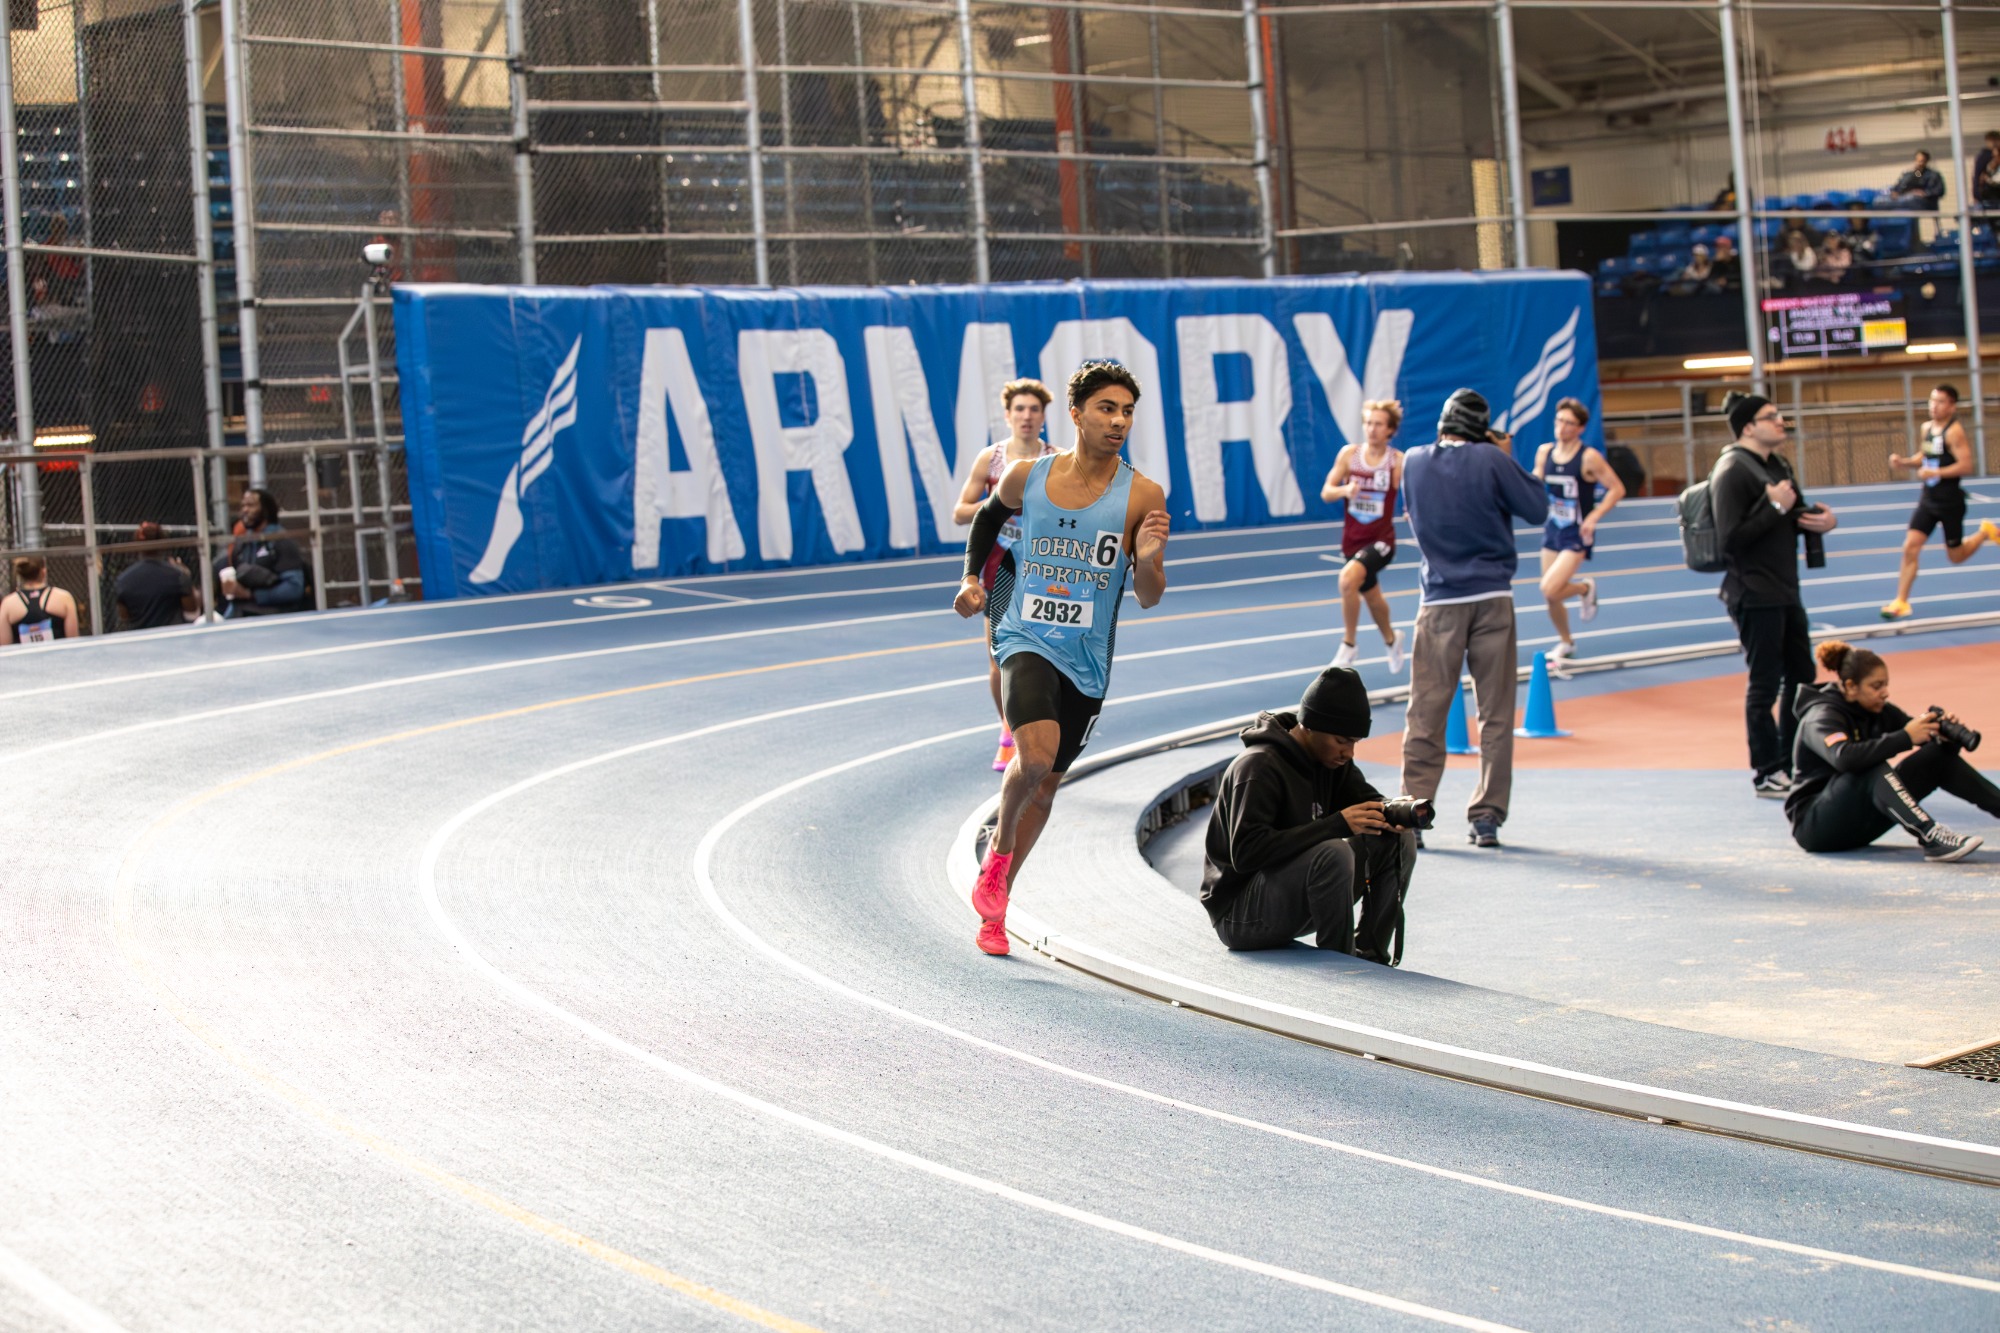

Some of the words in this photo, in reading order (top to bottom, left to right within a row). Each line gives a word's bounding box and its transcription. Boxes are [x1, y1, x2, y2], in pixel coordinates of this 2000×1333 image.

[631, 307, 1415, 571] ARMORY
[1377, 471, 1387, 488] 3
[1096, 534, 1118, 567] 6
[1031, 598, 1082, 624] 2932
